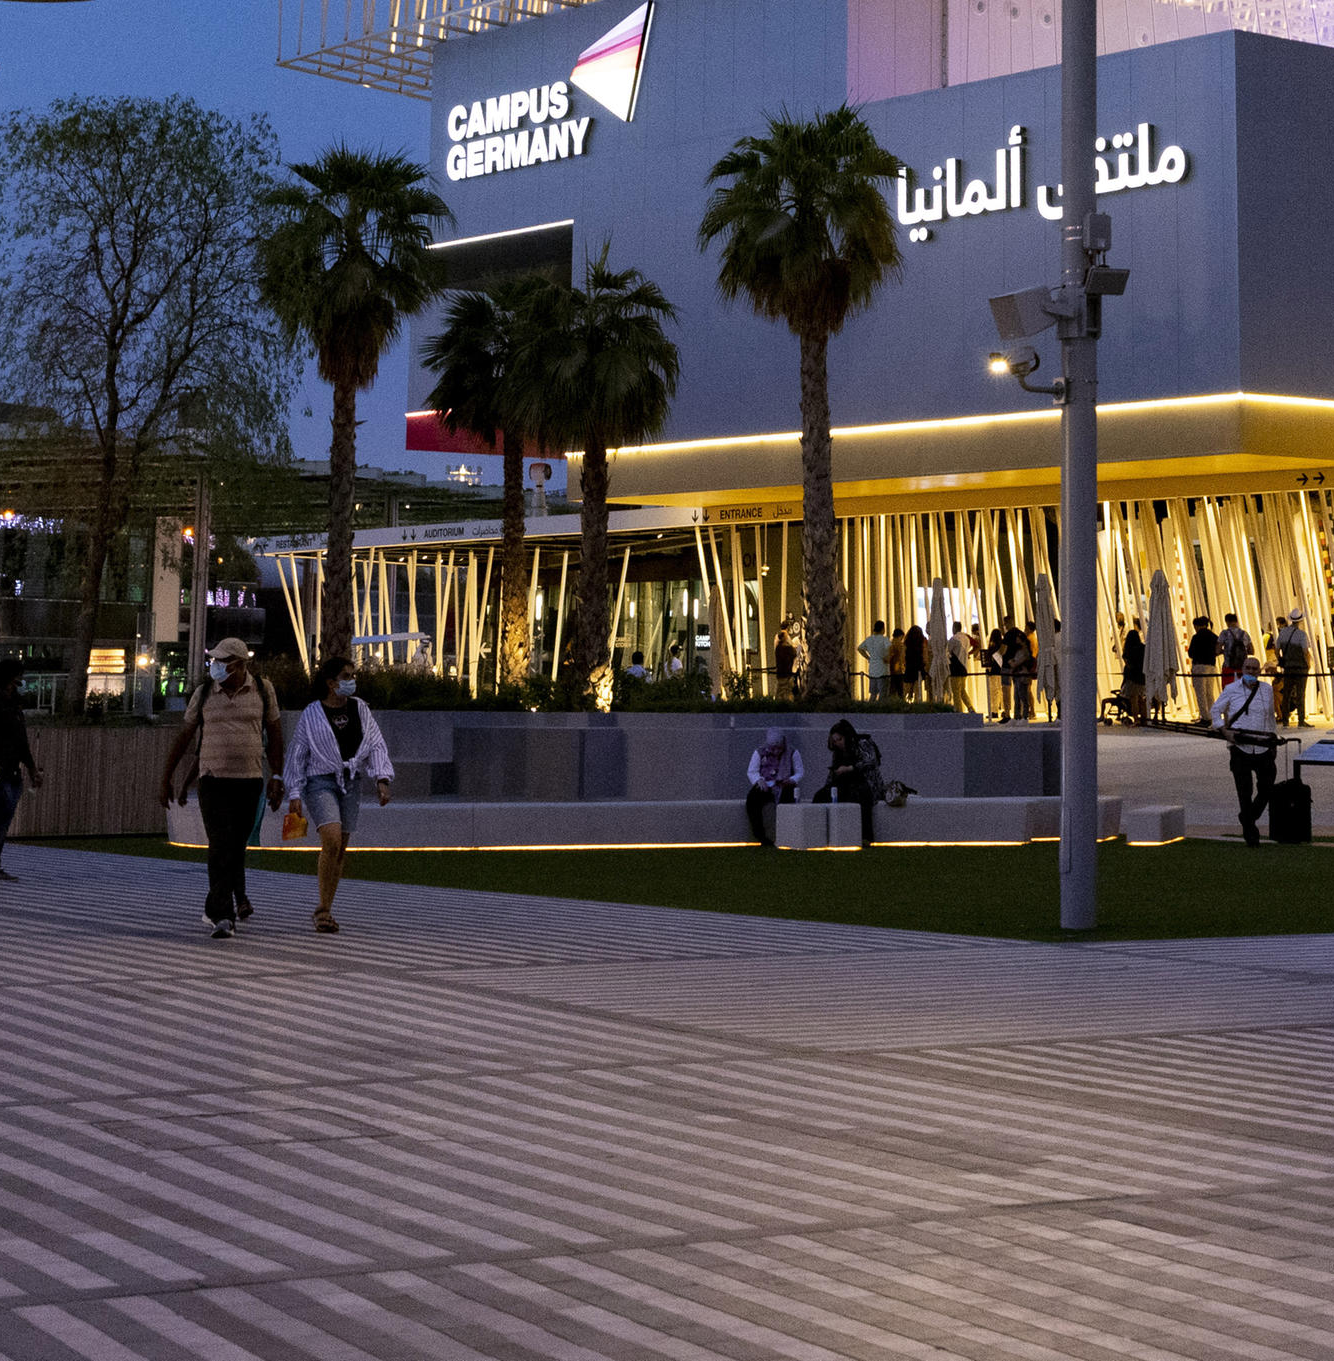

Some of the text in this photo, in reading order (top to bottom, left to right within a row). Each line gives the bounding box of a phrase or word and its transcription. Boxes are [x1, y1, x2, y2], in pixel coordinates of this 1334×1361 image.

[447, 80, 570, 142] CAMPUS
[446, 116, 592, 182] GERMANY
[897, 124, 1022, 242] ألمانيا
[423, 526, 465, 539] AUDITORIUM
[719, 507, 763, 520] ENTRANCE
